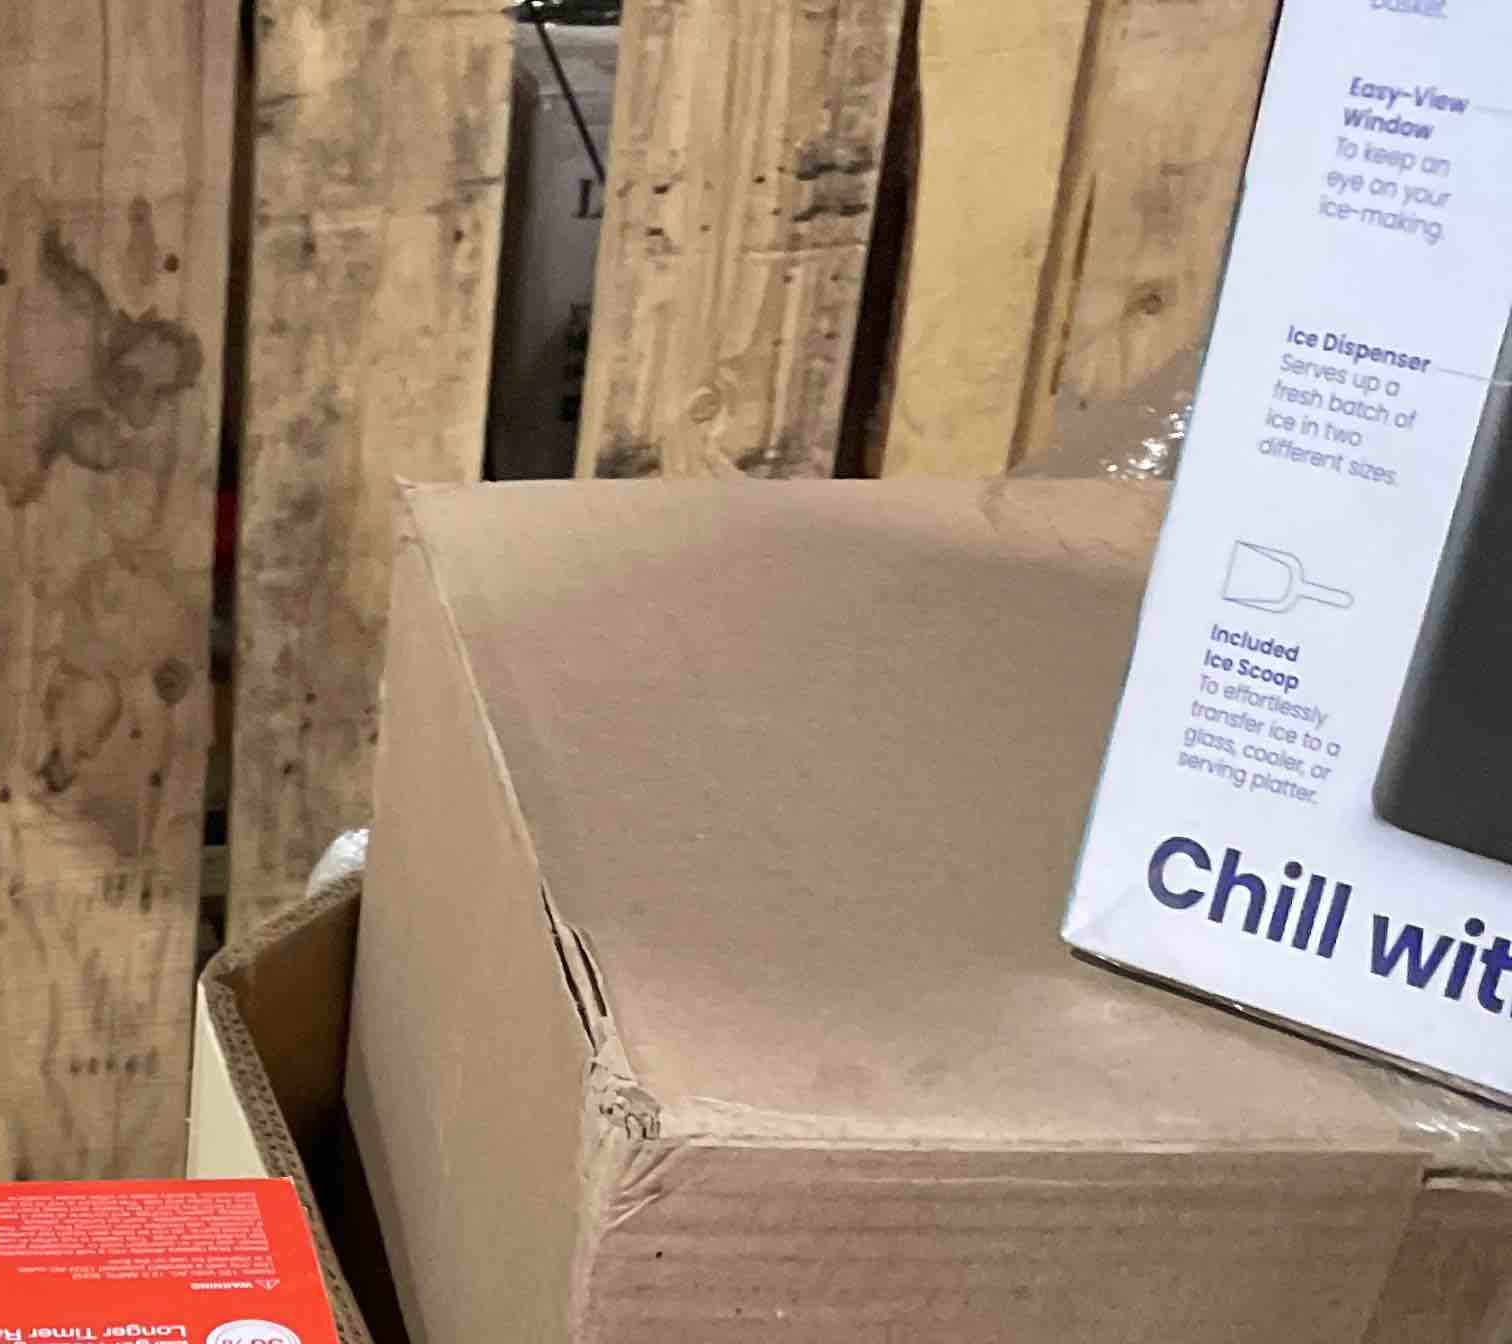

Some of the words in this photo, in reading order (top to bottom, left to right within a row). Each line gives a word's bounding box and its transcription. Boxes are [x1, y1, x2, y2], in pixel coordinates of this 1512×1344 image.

[1350, 76, 1469, 114] Easy-View
[1343, 110, 1433, 140] Window
[1288, 325, 1319, 349] Ice
[1324, 333, 1430, 374] Dispenser
[1280, 354, 1346, 384] Serves
[1352, 370, 1382, 396] up
[1272, 380, 1323, 409] fresh
[1329, 392, 1400, 423] batch
[1400, 408, 1417, 430] of
[1259, 436, 1343, 475] different
[1324, 423, 1364, 447] two
[1211, 624, 1300, 663] Included
[1204, 649, 1233, 673] Ice
[1238, 658, 1300, 693] Scoop
[1191, 701, 1264, 735] transfer
[1268, 720, 1296, 745] ice
[1301, 729, 1322, 749] to
[1224, 680, 1328, 728] effortlessly
[1184, 725, 1238, 757] glass,
[1243, 742, 1305, 773] cooler,
[1311, 764, 1332, 780] or
[1178, 752, 1247, 789] serving
[1251, 772, 1320, 805] platter.
[1147, 836, 1353, 959] Chill
[1371, 915, 1512, 1018] wit
[31, 1328, 95, 1340] Timer
[104, 1324, 186, 1337] Longer
